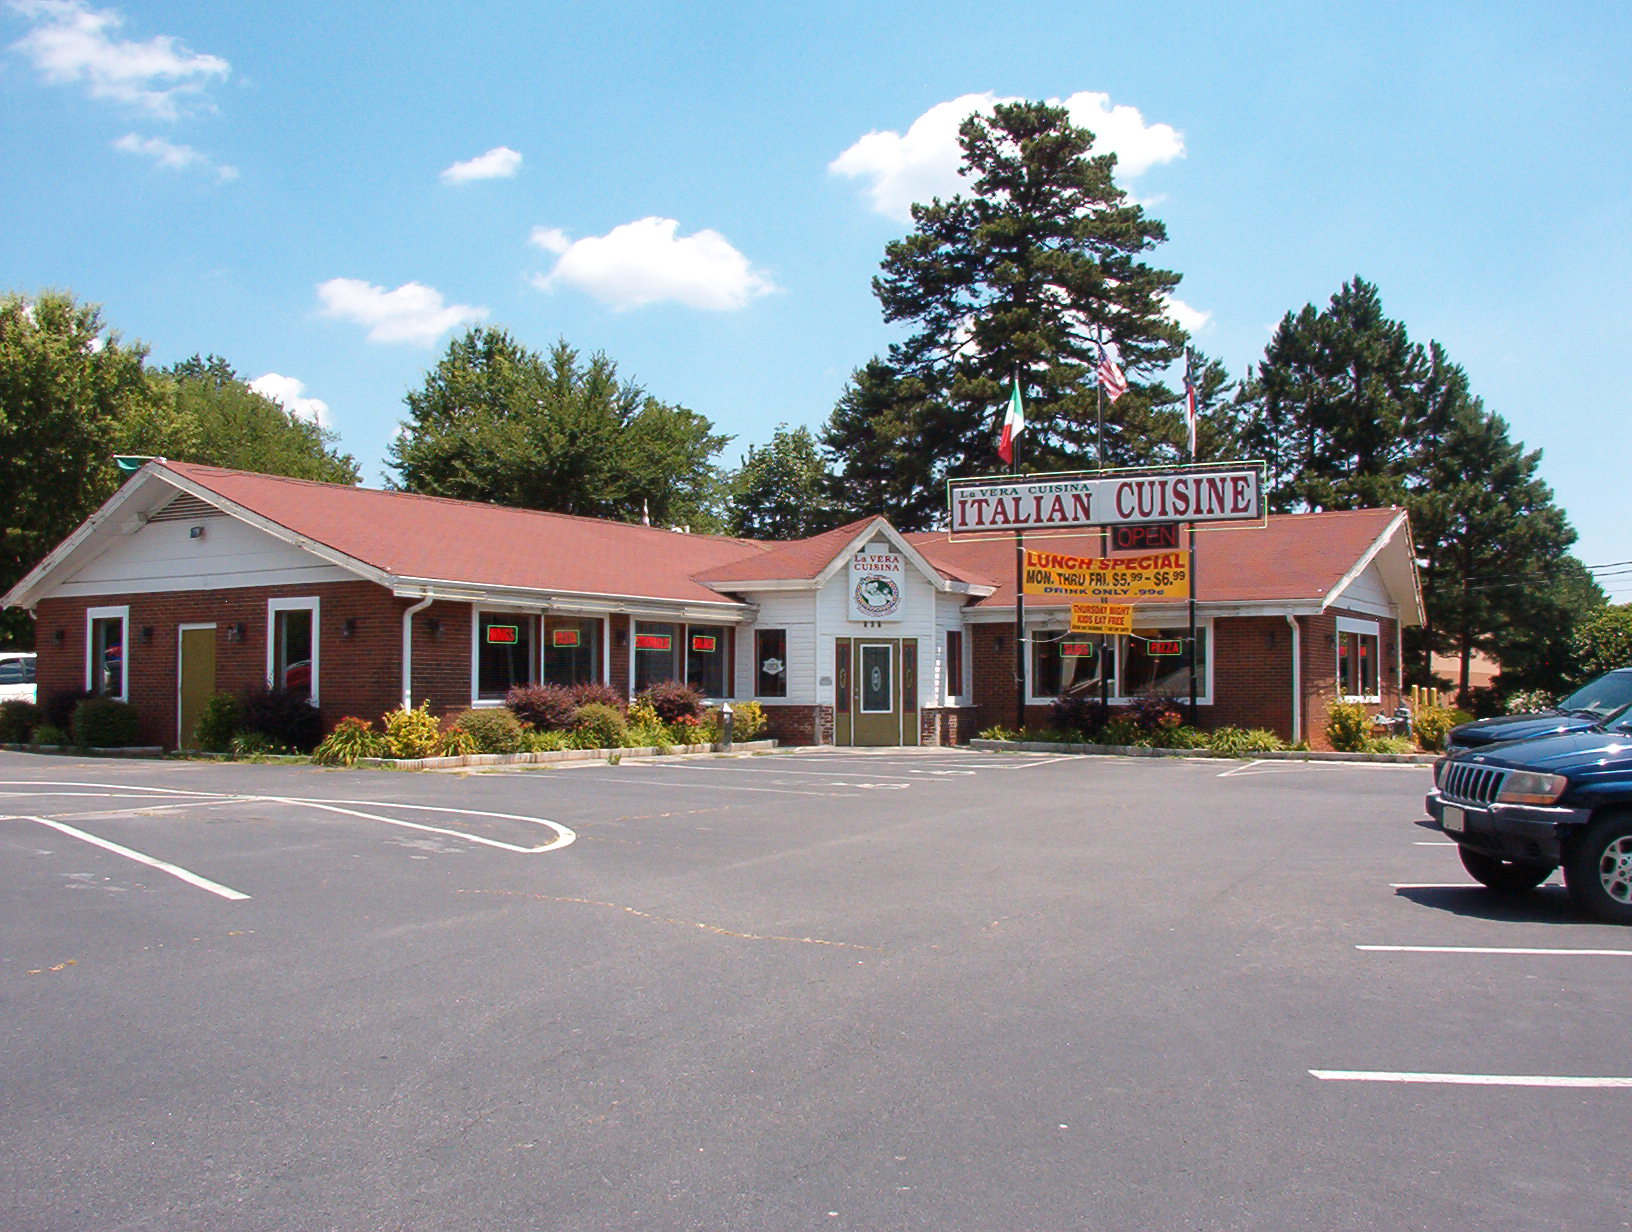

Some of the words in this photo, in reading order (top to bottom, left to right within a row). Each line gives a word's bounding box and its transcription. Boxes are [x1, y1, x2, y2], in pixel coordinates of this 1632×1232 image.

[979, 487, 1019, 496] VERA
[1028, 483, 1090, 494] CUISINA
[958, 493, 1092, 527] ITALIAN
[1116, 476, 1251, 519] CUISINE
[1118, 527, 1175, 547] OPEN
[1027, 552, 1092, 570] LUNCH
[1098, 553, 1185, 570] SPECIAL
[1026, 570, 1054, 585] MON.
[1057, 572, 1086, 586] THRU
[1089, 573, 1109, 586] FRI.
[1077, 615, 1092, 624] KIDS
[1108, 617, 1124, 625] FREE
[1063, 644, 1089, 655] SUBS
[1151, 642, 1179, 653] PIZZA
